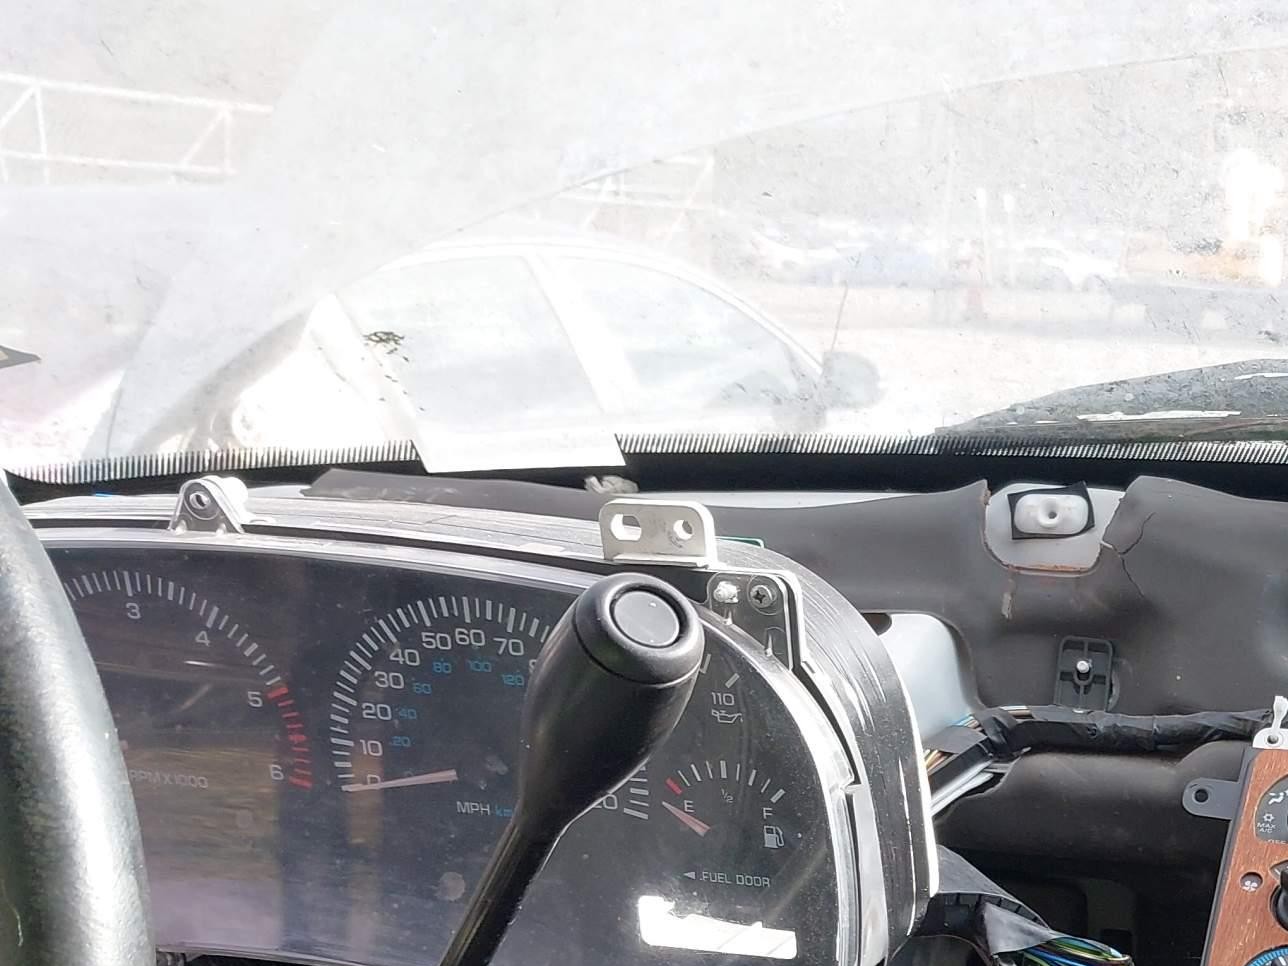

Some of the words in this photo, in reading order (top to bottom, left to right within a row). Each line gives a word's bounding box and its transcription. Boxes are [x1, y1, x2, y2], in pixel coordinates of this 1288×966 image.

[125, 602, 141, 619] 3
[195, 630, 211, 646] 4
[421, 631, 452, 650] 50
[455, 628, 485, 646] 60
[493, 637, 524, 656] 70
[389, 648, 420, 666] 40
[432, 660, 452, 674] 80
[374, 671, 404, 689] 30
[247, 691, 263, 708] 5
[711, 691, 735, 706] 110
[361, 702, 392, 721] 20
[359, 738, 383, 757] 10
[269, 764, 285, 781] 6
[456, 801, 490, 816] MPH
[683, 799, 695, 813] E
[763, 807, 773, 820] F
[702, 871, 732, 885] FUEL
[735, 874, 770, 888] DOOR
